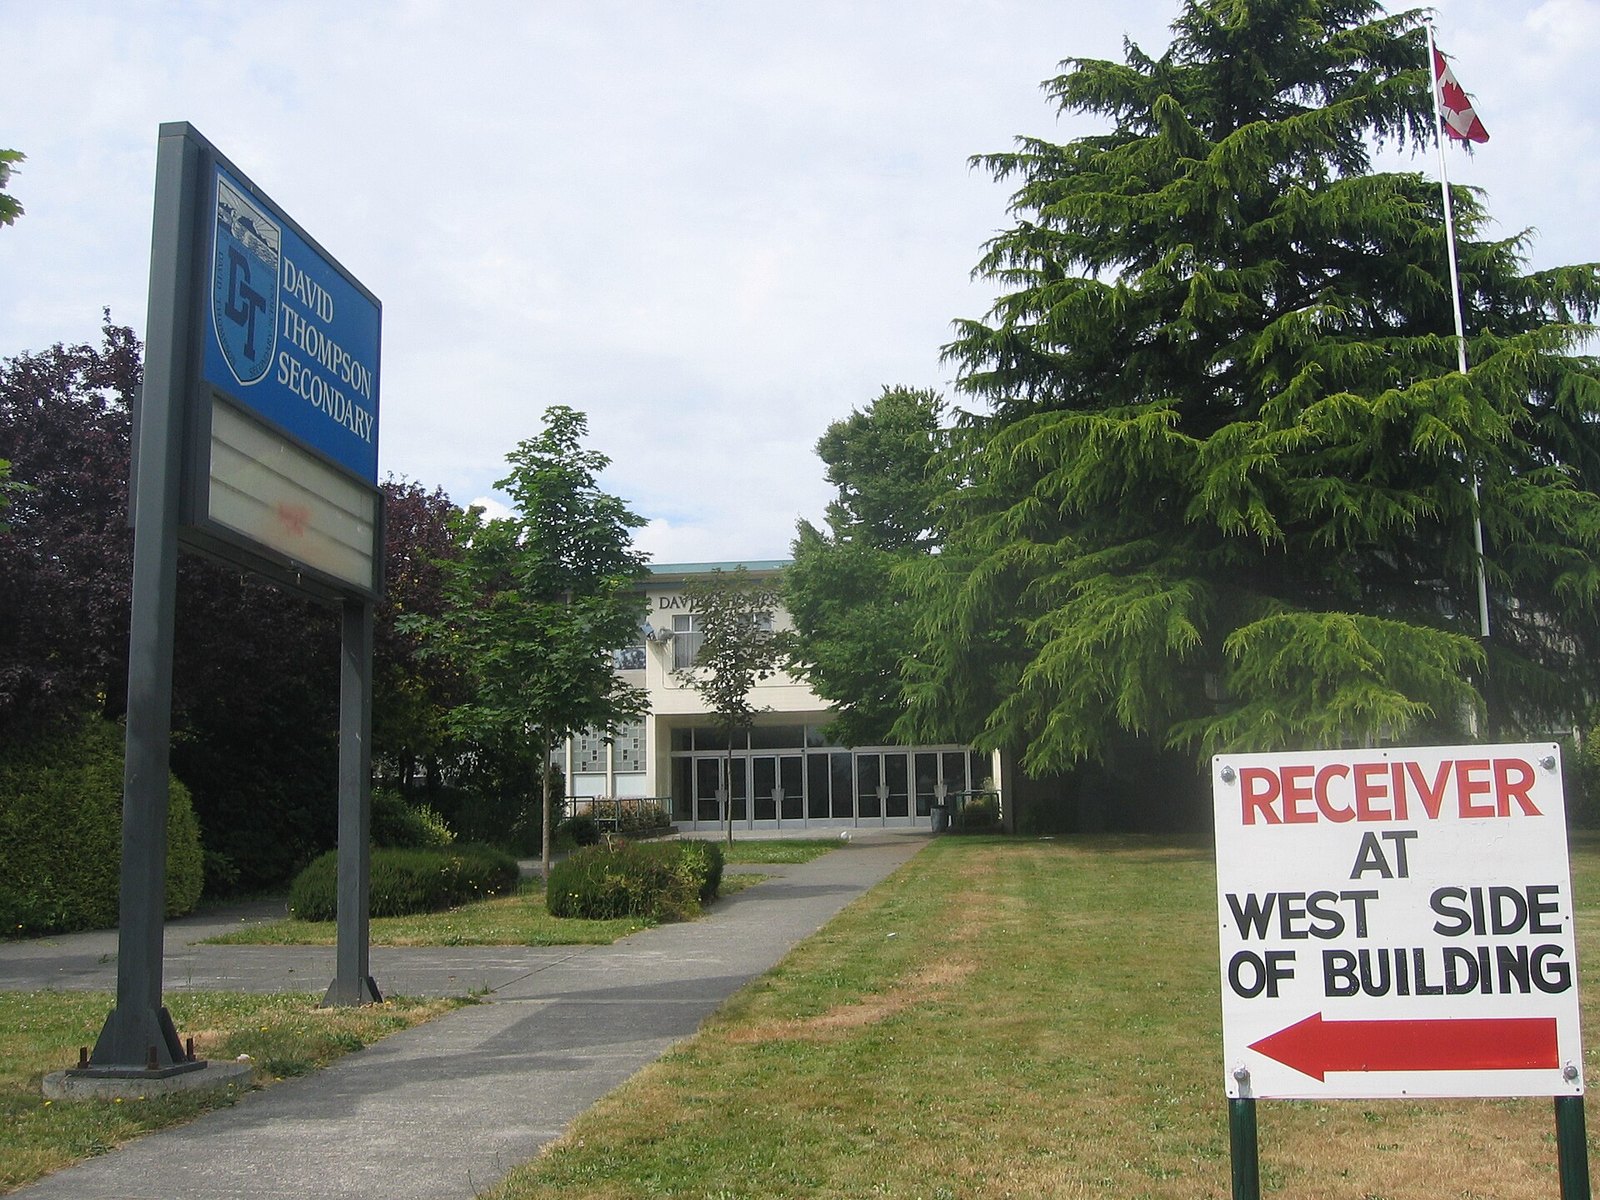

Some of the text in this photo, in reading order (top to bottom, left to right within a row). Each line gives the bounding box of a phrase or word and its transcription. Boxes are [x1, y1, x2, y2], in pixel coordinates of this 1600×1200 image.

[282, 256, 334, 324] DAVID
[281, 302, 372, 400] THOMPSON
[277, 351, 374, 444] SECONDARY
[1239, 758, 1544, 825] RECEIVER
[1349, 830, 1418, 879] AT
[1225, 885, 1562, 940] WEST SIDE
[1228, 944, 1572, 999] OF BUILDING
